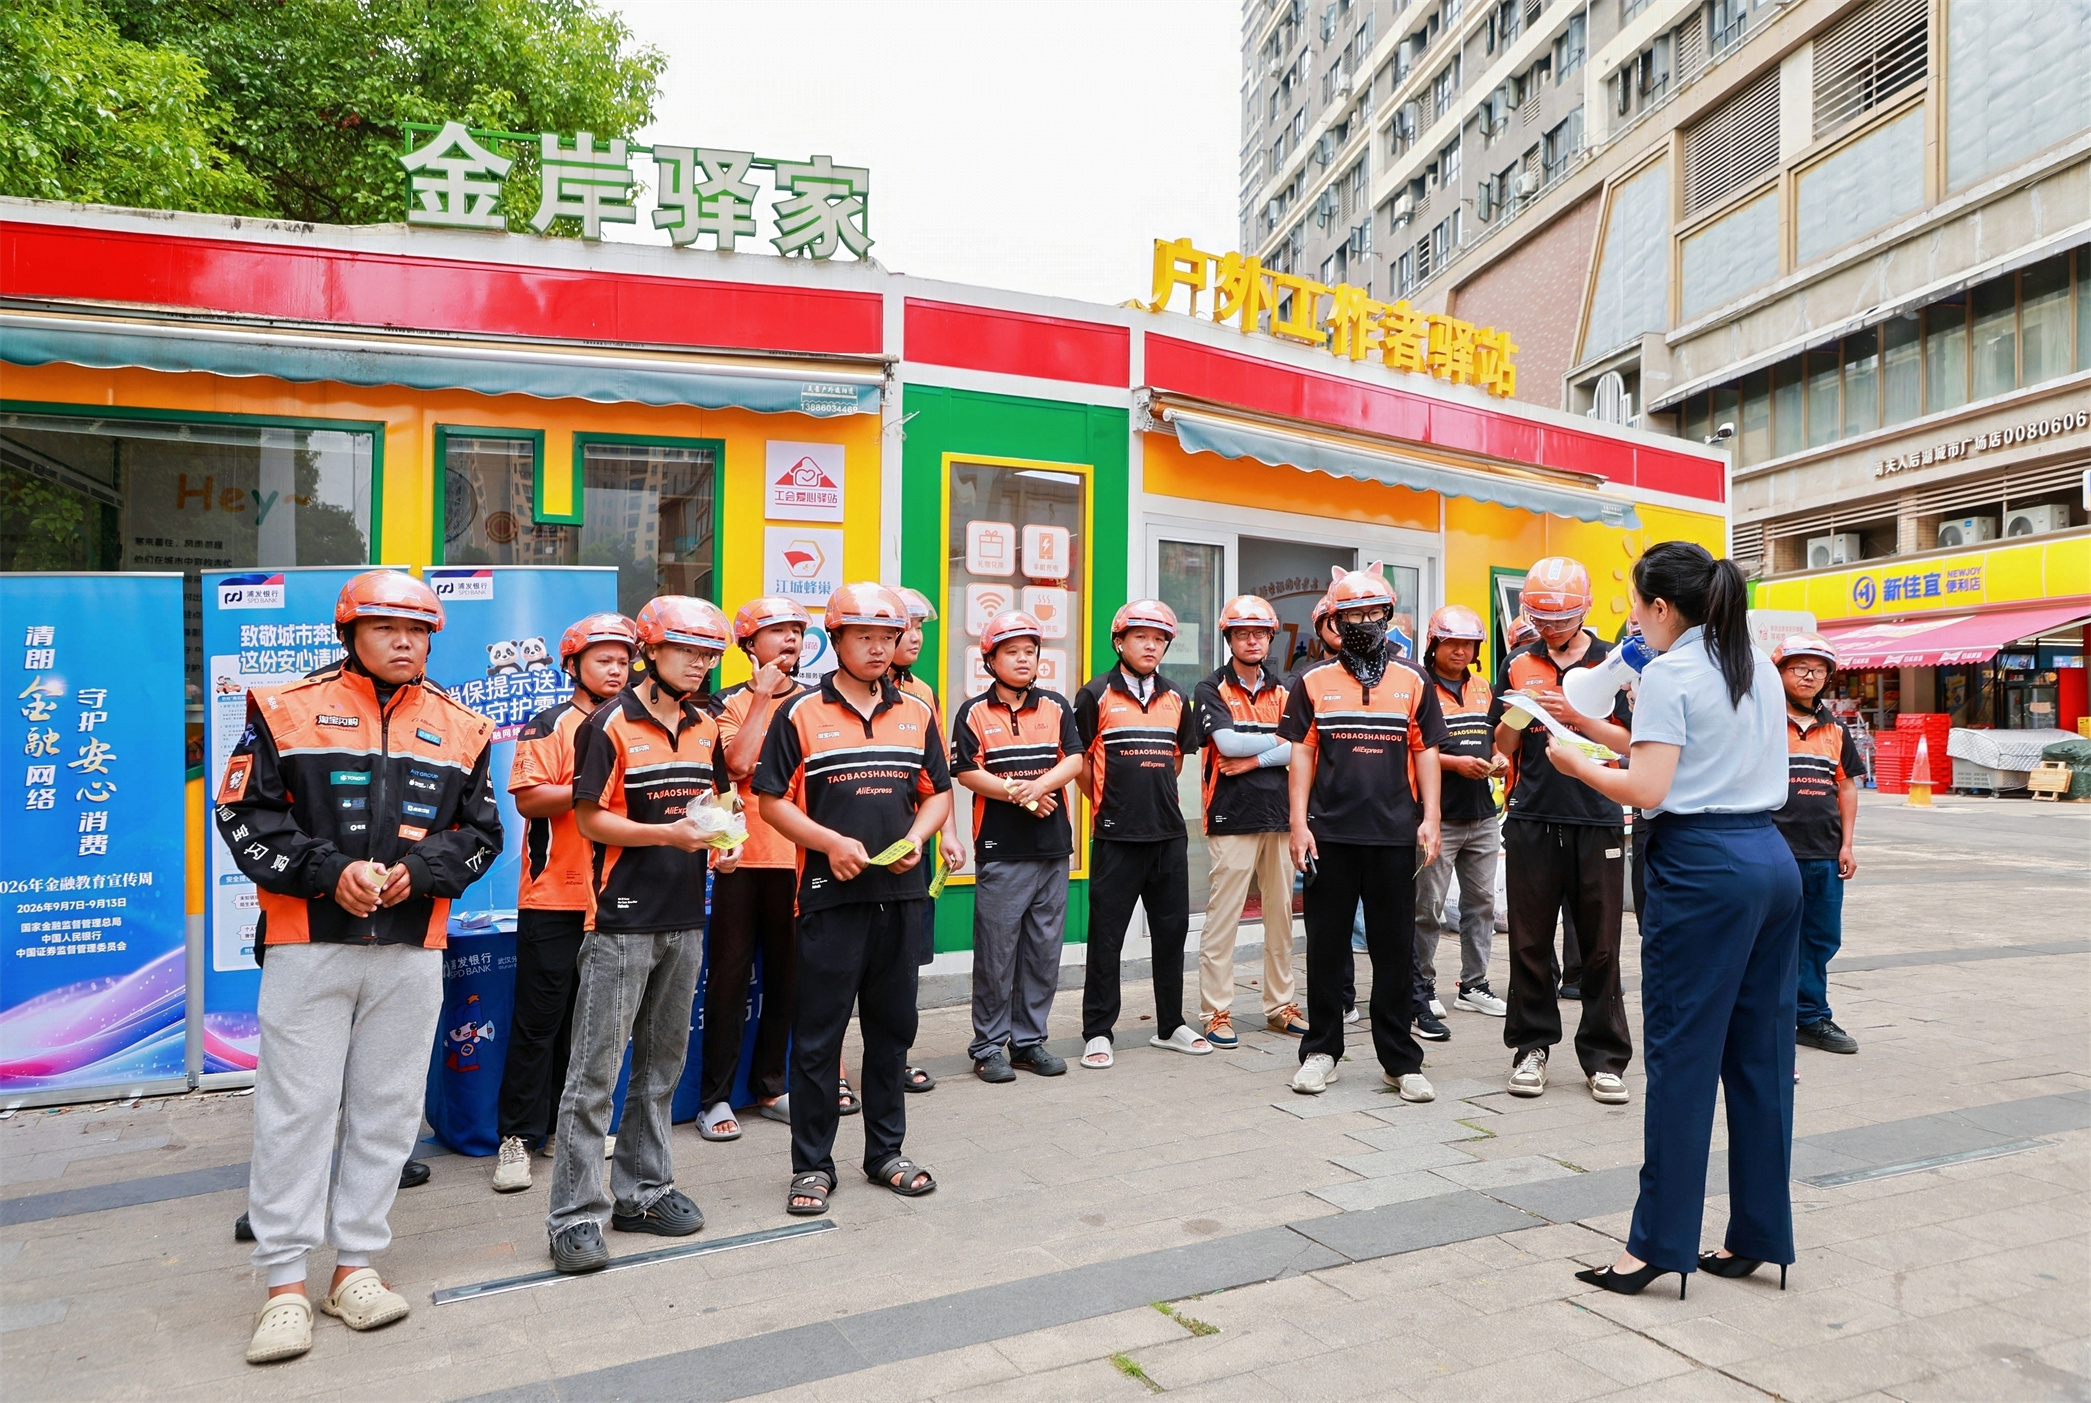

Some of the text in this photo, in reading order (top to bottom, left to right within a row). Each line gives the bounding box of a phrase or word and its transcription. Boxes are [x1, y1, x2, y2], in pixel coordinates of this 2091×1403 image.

[398, 120, 875, 260] 金岸驿家
[1149, 237, 1519, 398] 户外工作者驿站
[774, 490, 838, 503] 工会爱心驿站
[1033, 563, 1059, 572] 手机充电
[1947, 567, 1982, 578] NEWJOY
[458, 582, 488, 590] 浦发银行
[775, 579, 832, 595] 江城蜂巢
[1883, 572, 1942, 602] 新佳宜
[1946, 577, 1980, 593] 便利店
[247, 590, 278, 598] 浦发银行
[491, 726, 521, 741] 融网络
[1331, 732, 1402, 742] TAOBAOSHANGOU
[1352, 746, 1384, 754] AliExpress
[1140, 761, 1166, 769] AliExpress
[67, 688, 118, 857] 守护安心消费
[827, 770, 910, 784] TAOBAOSHANGOU
[855, 786, 893, 796] AliExpress
[664, 806, 687, 815] AliExp
[0, 872, 153, 894] 026年金融教育宣传周
[16, 897, 127, 914] 2026年9月7日-9月13日
[20, 917, 122, 933] 国家金融监督管理总局
[41, 931, 102, 944] 中国人民银行
[16, 942, 127, 958] 中国证券监督管理委员会
[450, 964, 492, 980] SPD BANK
